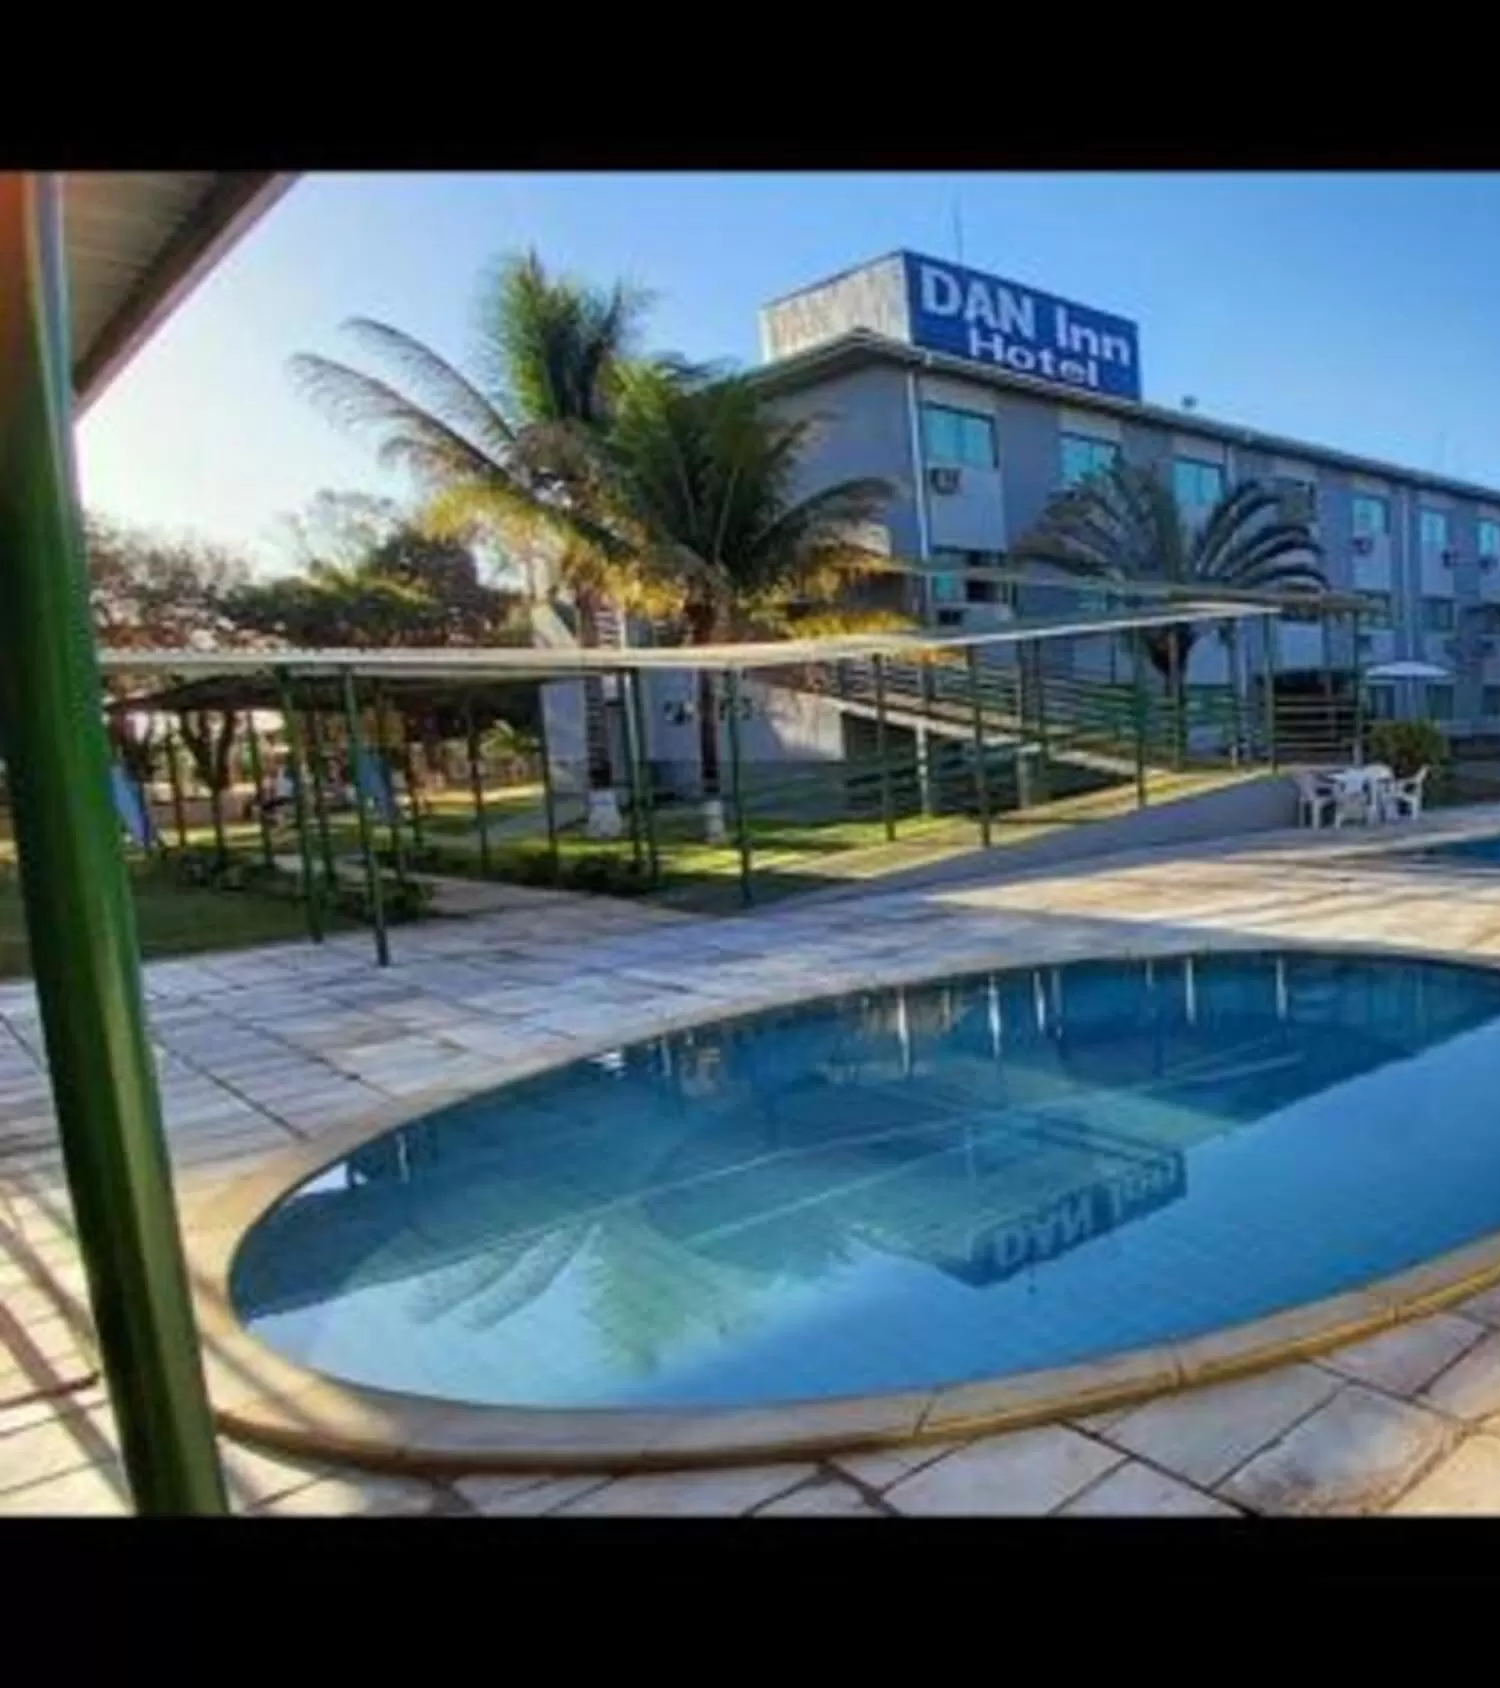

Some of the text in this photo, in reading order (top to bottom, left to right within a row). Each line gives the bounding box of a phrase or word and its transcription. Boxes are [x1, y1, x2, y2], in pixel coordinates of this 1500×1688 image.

[920, 265, 1035, 342] DAN
[1056, 303, 1131, 366] Inn
[969, 328, 1100, 388] Hotel
